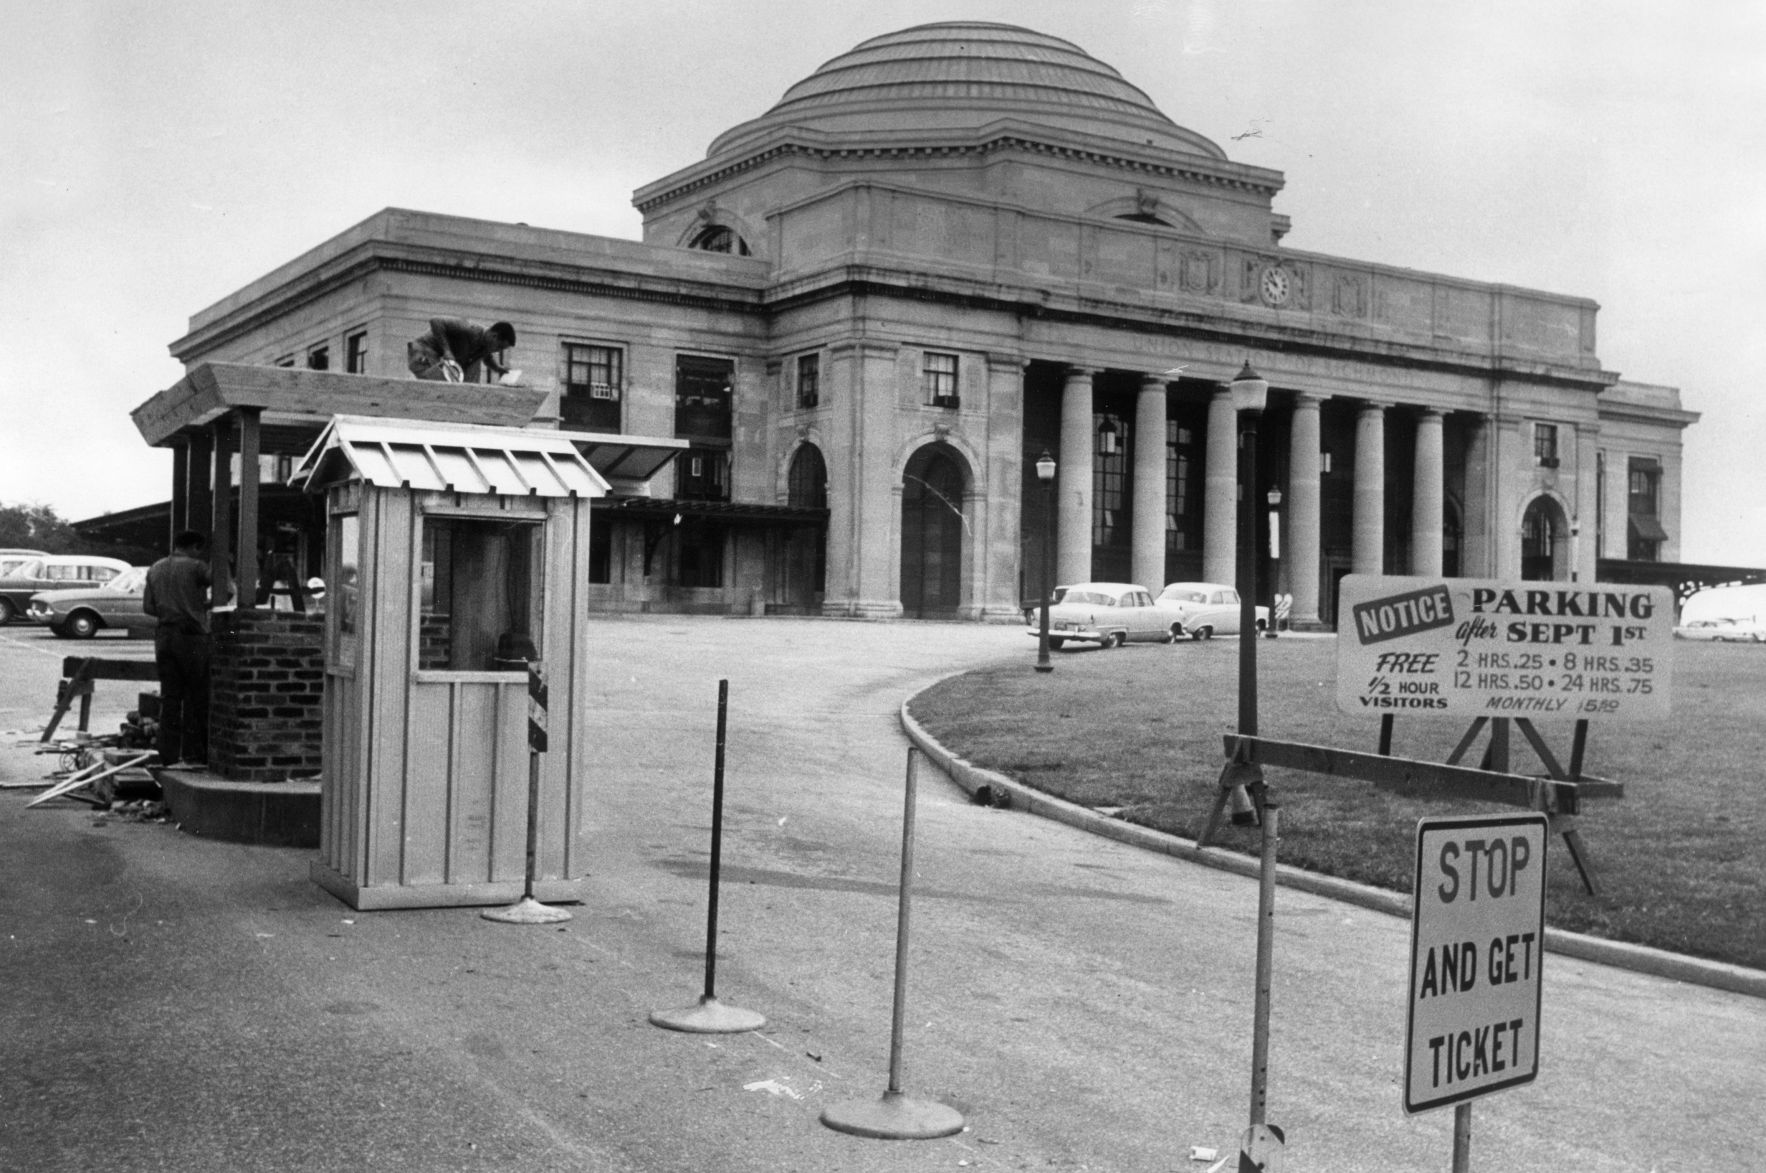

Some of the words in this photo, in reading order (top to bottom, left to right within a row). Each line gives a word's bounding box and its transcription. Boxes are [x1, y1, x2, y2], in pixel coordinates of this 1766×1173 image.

[1133, 334, 1191, 356] UNION
[1206, 343, 1277, 368] STATION
[1360, 592, 1450, 638] NOTICE
[1470, 588, 1656, 619] PARKING
[1455, 615, 1498, 647] after
[1506, 621, 1596, 645] SEPT
[1610, 625, 1648, 646] 1ST
[1376, 652, 1440, 673] FREE
[1457, 649, 1469, 667] 2
[1563, 652, 1577, 671] 8
[1399, 682, 1439, 695] HOUR
[1454, 670, 1472, 689] 12
[1561, 673, 1584, 692] 24
[1359, 696, 1448, 709] VISITORS
[1486, 697, 1568, 711] MONTHLY
[1438, 836, 1530, 904] STOP
[1420, 941, 1477, 999] AND
[1488, 932, 1535, 986] GET
[1429, 1018, 1523, 1088] TICKET
